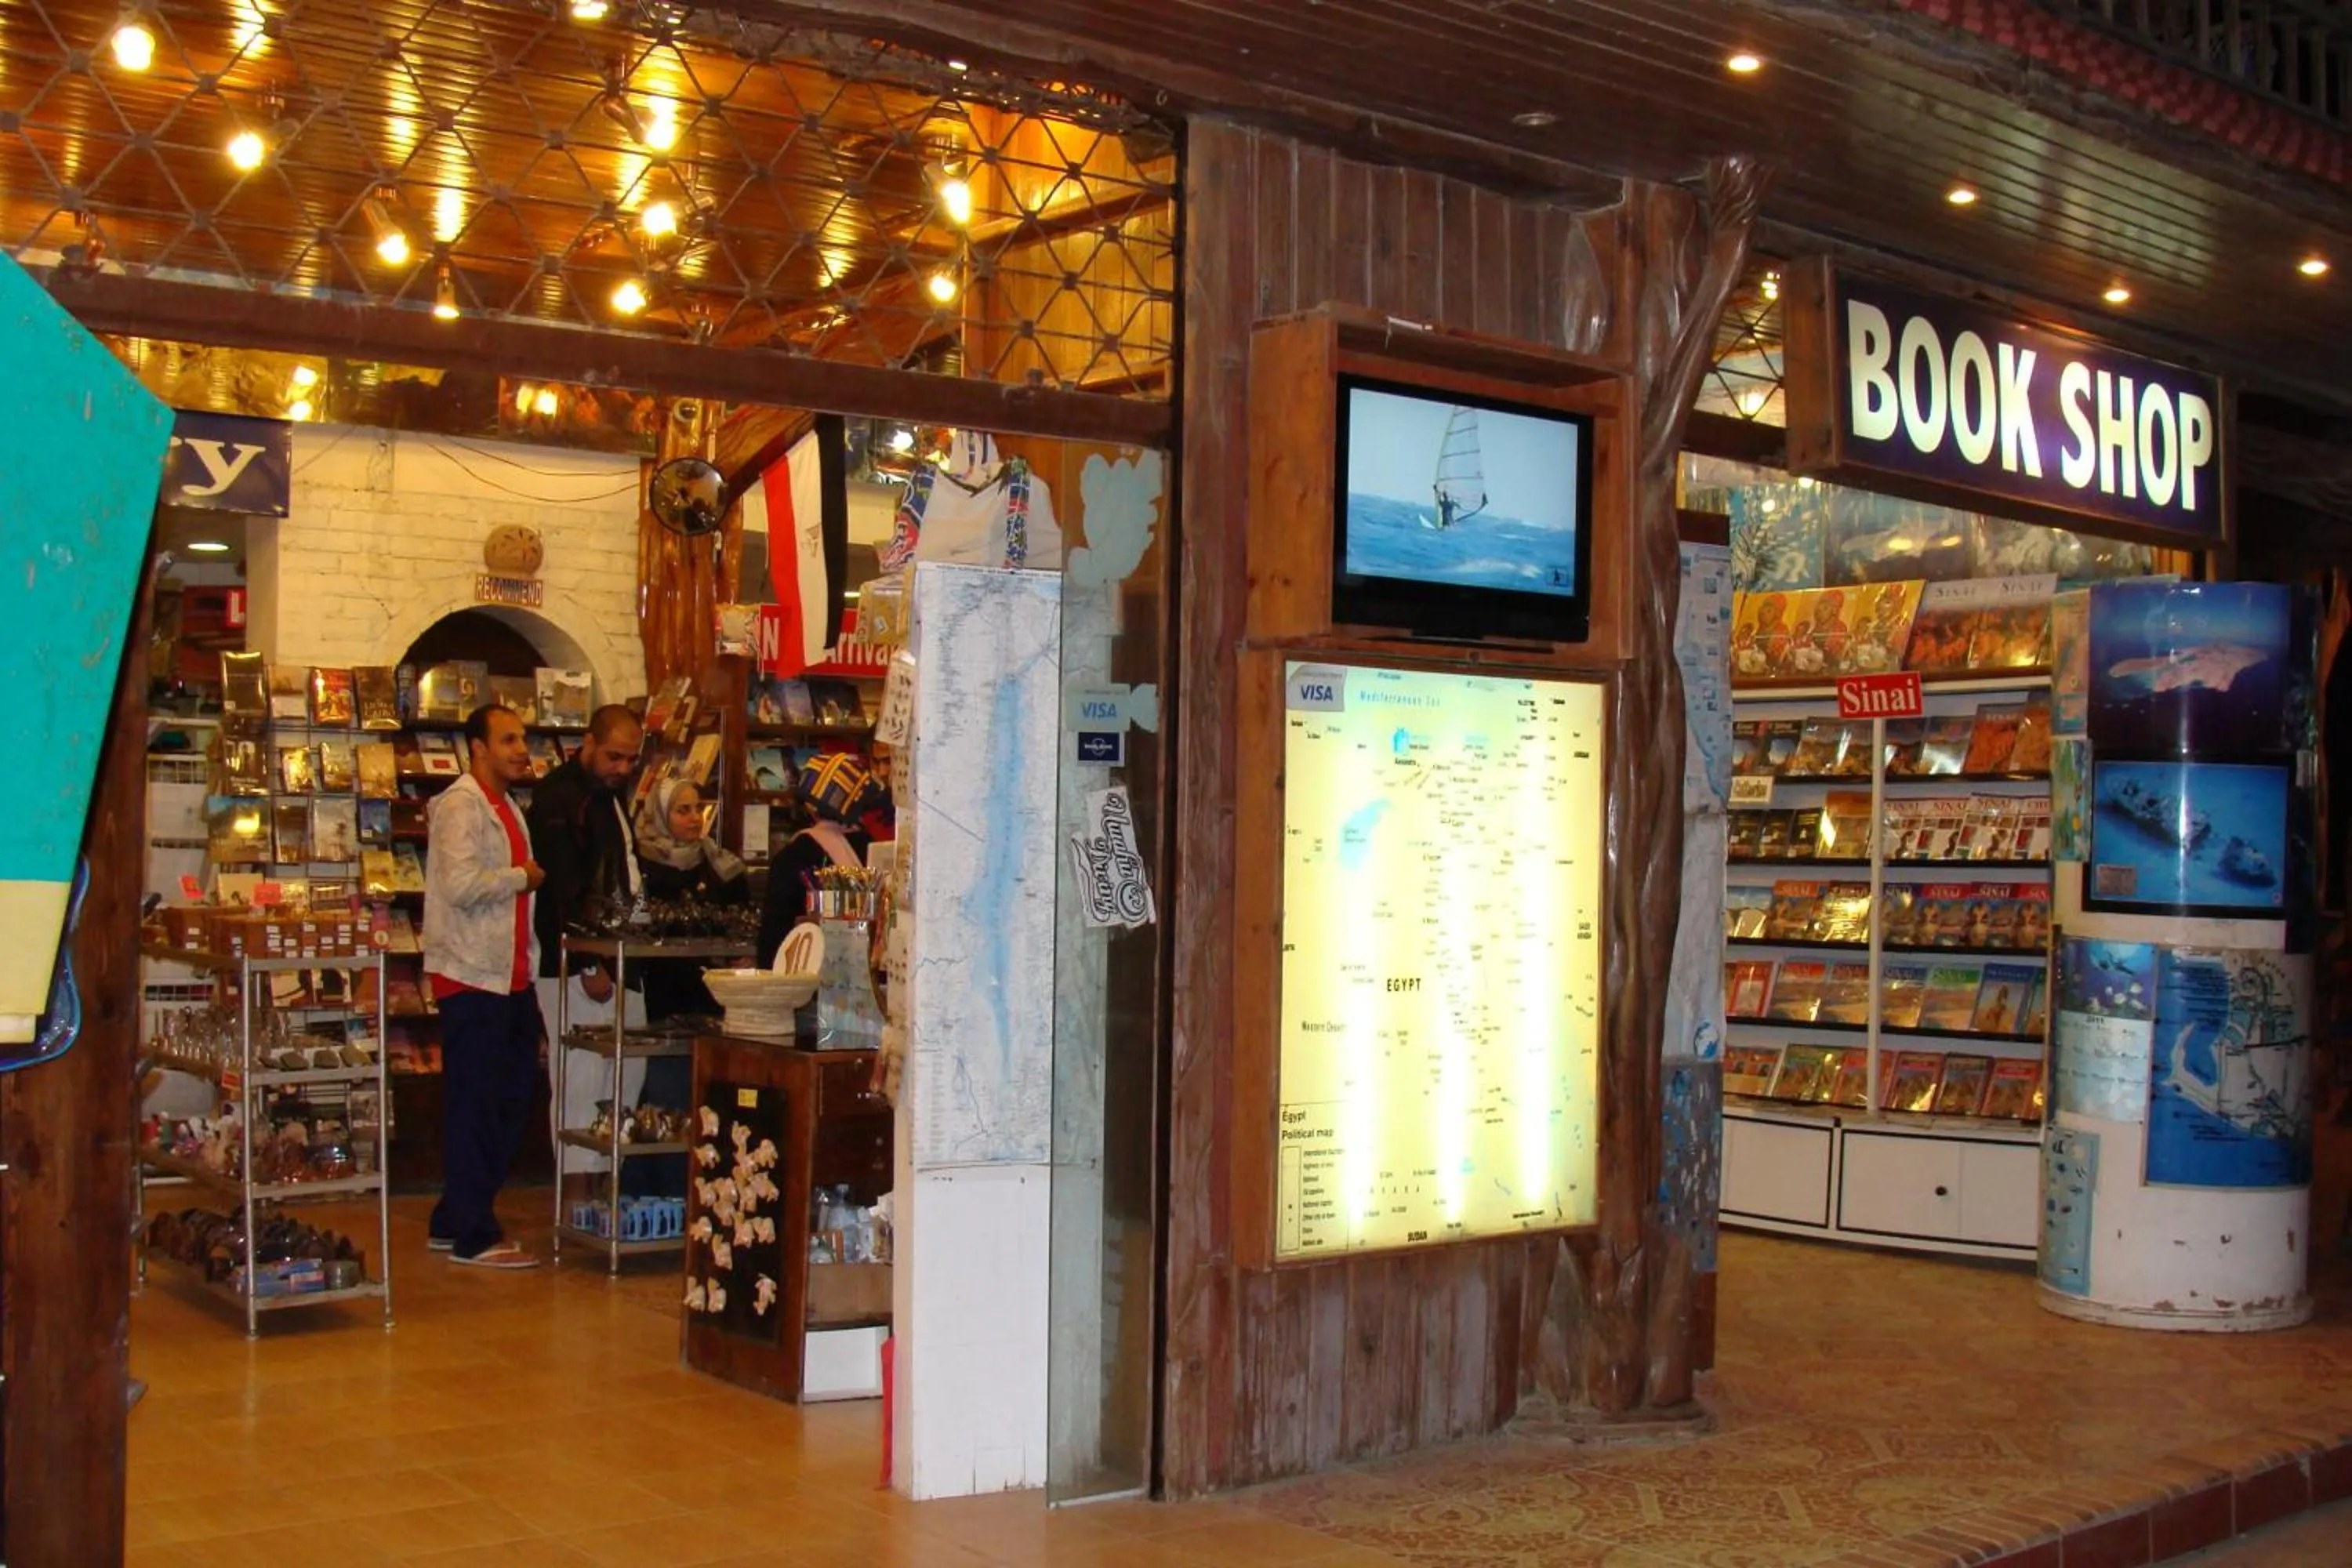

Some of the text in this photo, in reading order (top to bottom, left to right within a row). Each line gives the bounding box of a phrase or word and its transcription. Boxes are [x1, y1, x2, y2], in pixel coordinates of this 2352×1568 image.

[1848, 299, 2213, 511] BOOK SHOP
[476, 575, 543, 606] RECOMMEND
[826, 631, 895, 666] Arriva
[1301, 684, 1334, 702] VISA
[1842, 677, 1917, 714] Sinai
[1081, 702, 1117, 719] VISA
[1387, 978, 1421, 992] EGYPT
[1282, 1111, 1305, 1123] Egypt
[1282, 1129, 1314, 1141] Political
